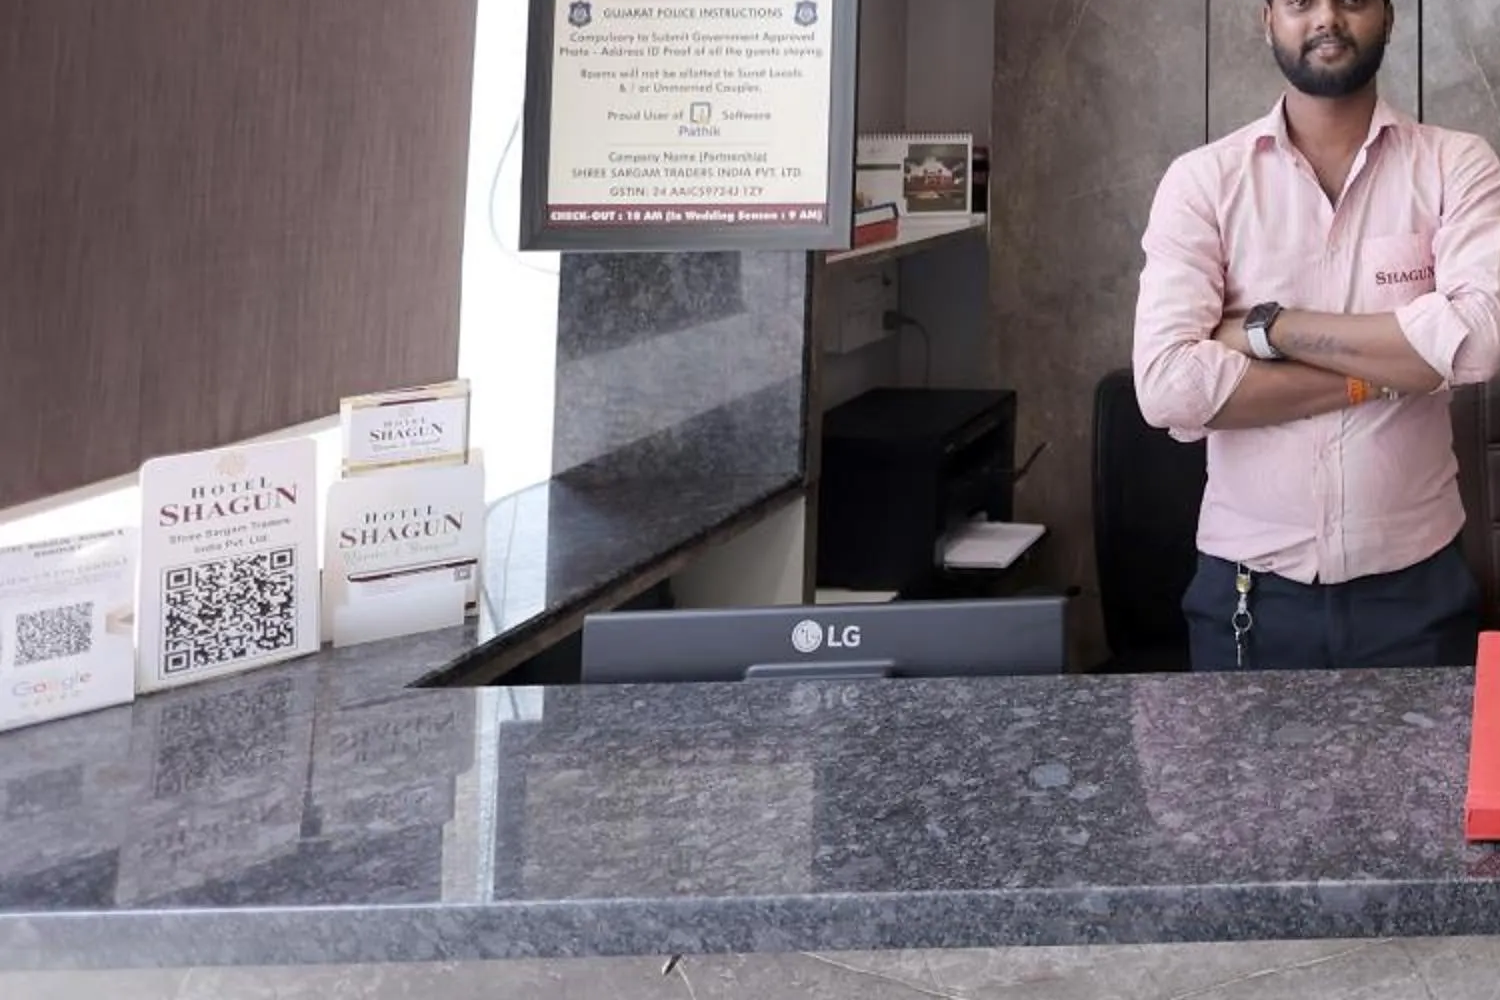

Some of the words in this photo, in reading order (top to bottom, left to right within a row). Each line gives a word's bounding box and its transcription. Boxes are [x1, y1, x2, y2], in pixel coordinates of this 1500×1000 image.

[603, 7, 654, 18] GUJARAT
[657, 7, 695, 18] POLICE
[699, 7, 783, 18] INSTRUCTIONS
[637, 32, 649, 41] to
[692, 32, 760, 41] Government
[762, 32, 815, 43] Approved
[602, 47, 644, 57] Address
[663, 47, 691, 57] Proof
[694, 47, 706, 57] of
[620, 68, 639, 78] will
[642, 68, 659, 78] not
[663, 68, 677, 78] be
[607, 110, 641, 120] Proud
[643, 110, 669, 120] User
[672, 110, 684, 120] of
[722, 110, 772, 121] Software
[678, 125, 721, 137] Pathik
[608, 152, 659, 164] Company
[663, 152, 696, 162] Name
[572, 167, 607, 178] SHREE
[611, 167, 661, 178] SARGAM
[665, 167, 714, 178] TRADERS
[717, 167, 751, 178] INDIA
[550, 210, 616, 222] CHECK-OUT
[643, 210, 663, 222] AM
[685, 209, 735, 223] Wedding
[737, 209, 778, 221] Season
[1375, 265, 1435, 285] SHAGUN
[369, 422, 444, 443] SHAGUN
[190, 476, 272, 499] HOTEL
[159, 480, 298, 528] SHAGUN
[364, 505, 434, 525] HOTEL
[339, 511, 464, 549] SHAGUN
[827, 625, 861, 647] LG
